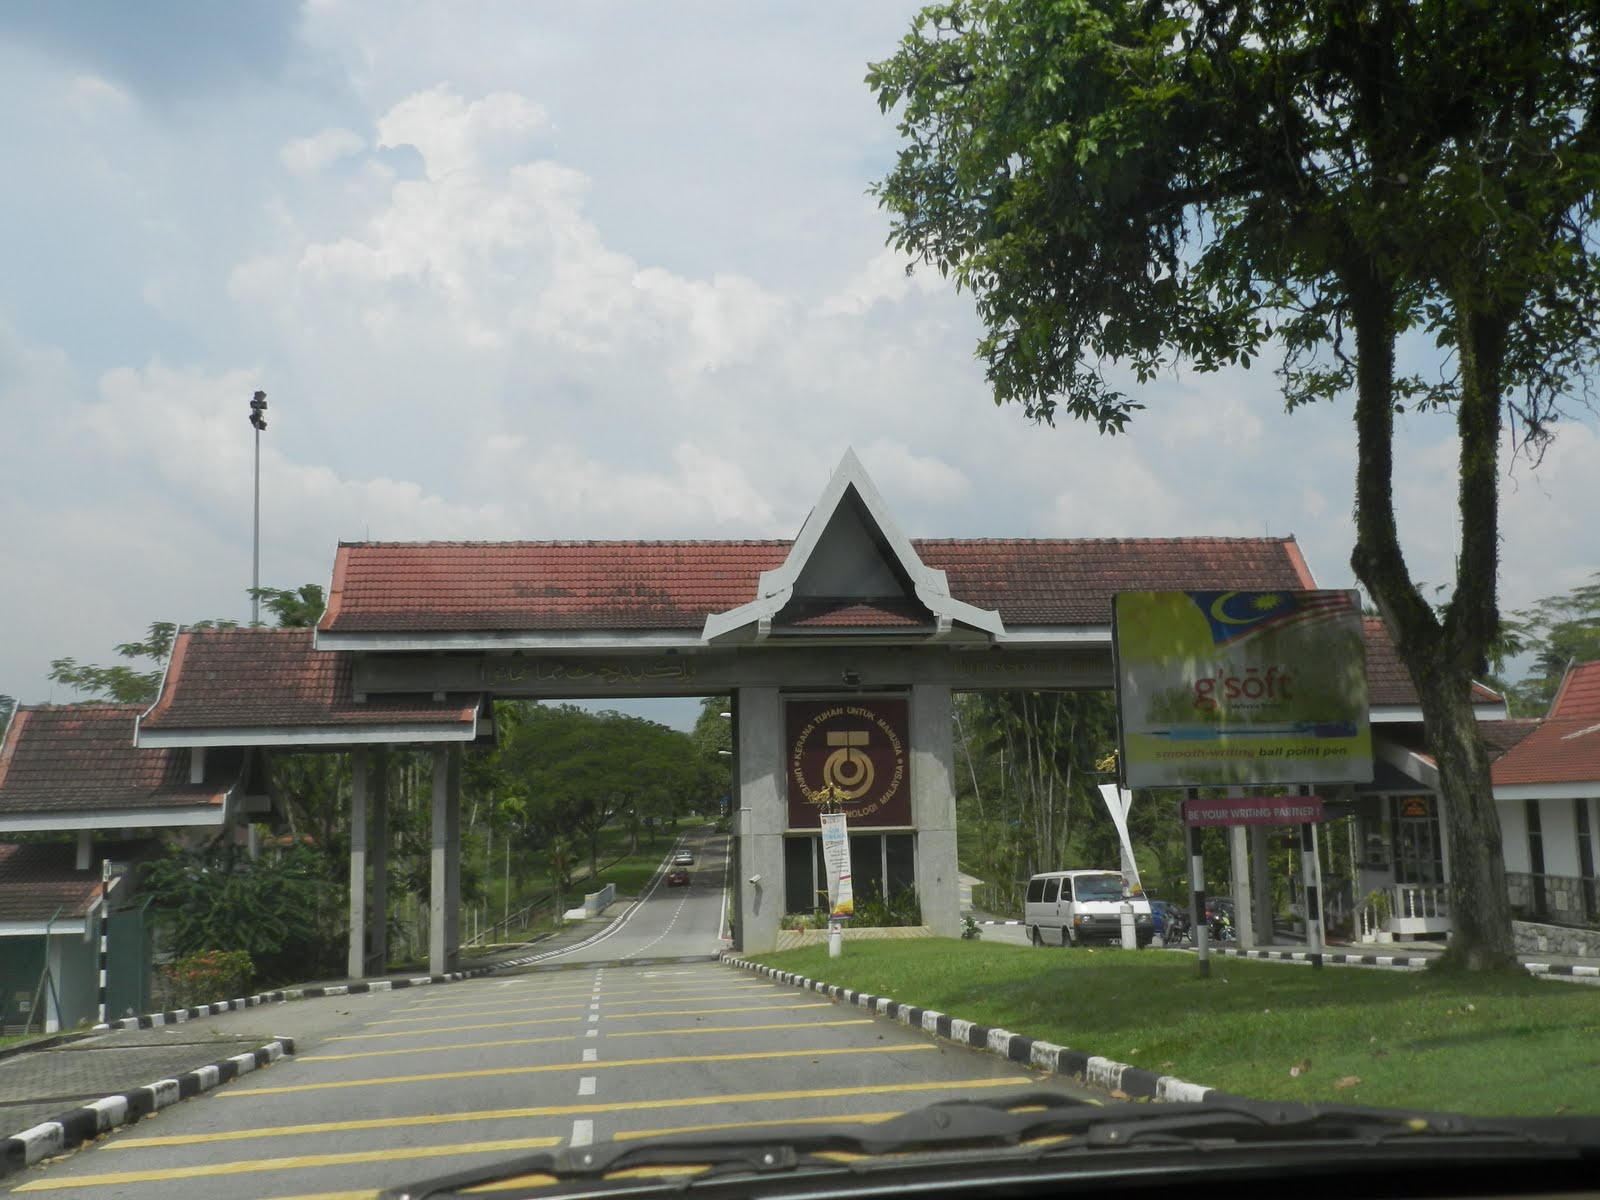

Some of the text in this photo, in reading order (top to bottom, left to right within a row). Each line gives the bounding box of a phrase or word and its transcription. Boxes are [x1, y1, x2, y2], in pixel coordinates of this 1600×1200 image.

[794, 706, 904, 761] KERANA TUHAN UNTUK MANUSIA
[1155, 746, 1348, 760] smooth-writing ball point pen
[830, 803, 879, 819] ENOLOGI
[879, 764, 904, 806] MALAYSIA
[1188, 810, 1200, 820] BE
[1202, 809, 1229, 820] YOUR
[1230, 808, 1272, 819] WRITING
[1274, 806, 1314, 817] PARTNER
